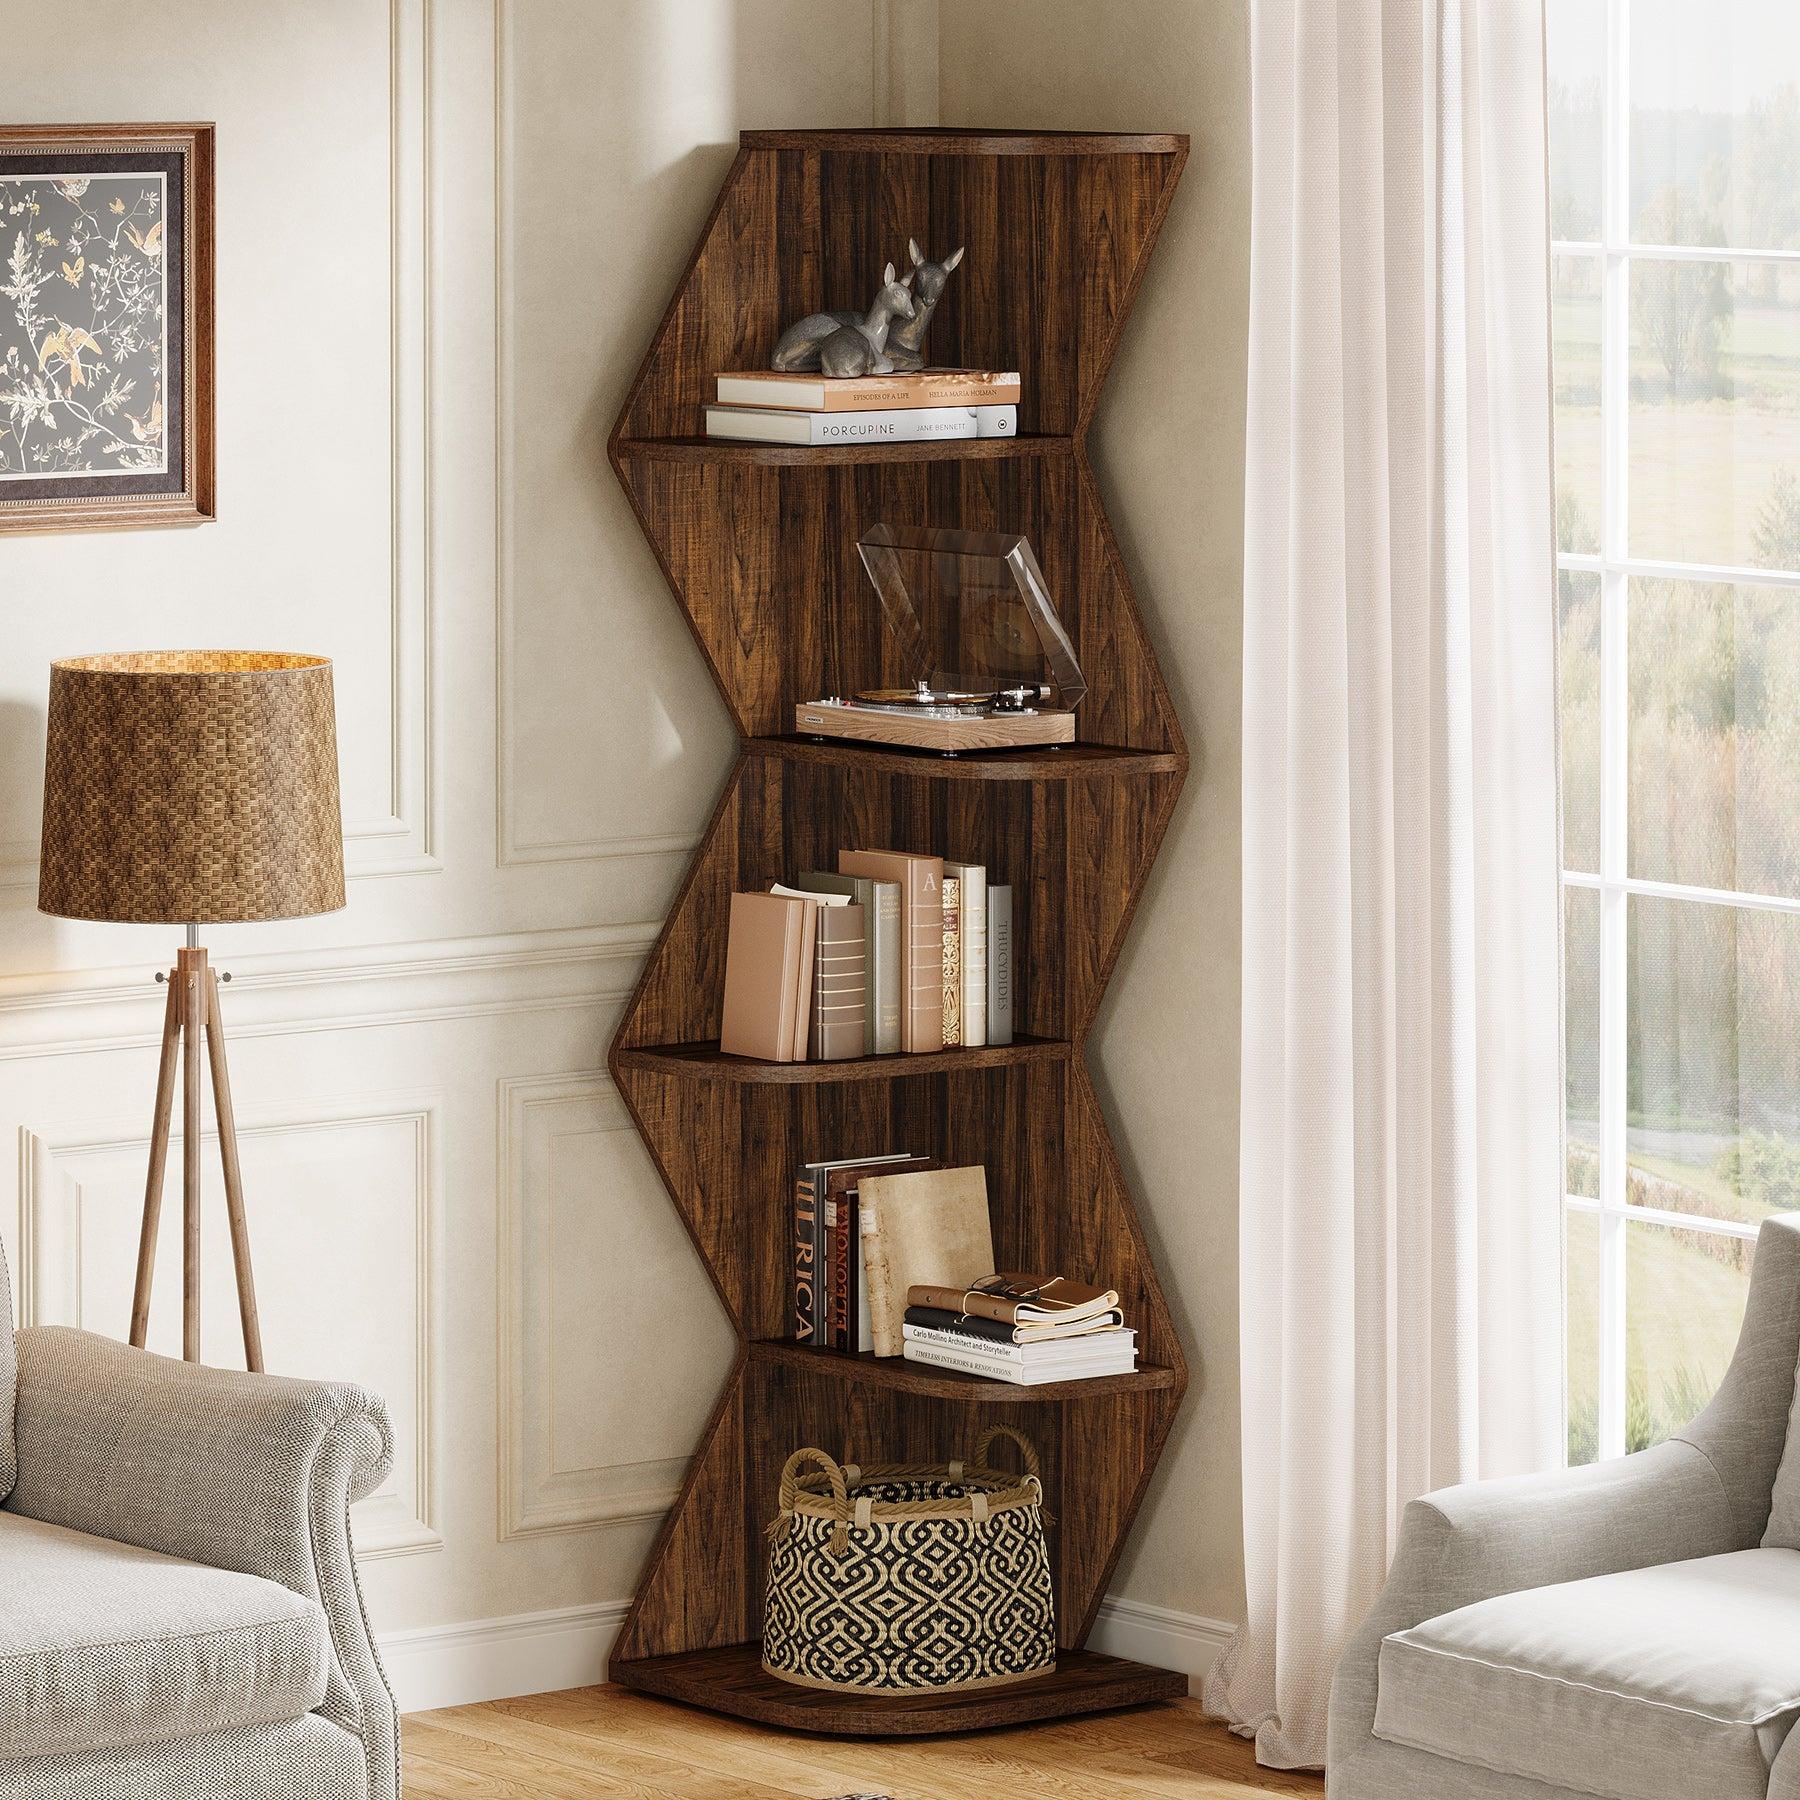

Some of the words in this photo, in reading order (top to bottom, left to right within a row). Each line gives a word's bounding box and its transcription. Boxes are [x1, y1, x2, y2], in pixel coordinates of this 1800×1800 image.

[853, 393, 882, 401] EPISODES
[896, 392, 910, 400] LIFE
[949, 389, 970, 398] MARIA
[822, 424, 895, 437] PORCUPINE
[916, 424, 934, 432] JANE
[934, 423, 966, 432] BENNETT
[922, 872, 938, 892] A
[997, 920, 1009, 1012] THUCYDIDES
[795, 1179, 815, 1341] ULRICA
[912, 1328, 928, 1339] Carlo
[927, 1331, 948, 1344] Mollino
[947, 1335, 972, 1349] Architect
[972, 1341, 982, 1350] and
[983, 1342, 1011, 1357] Storyteller
[914, 1350, 941, 1362] TIMELESS
[940, 1355, 970, 1368] INTERIORS
[974, 1362, 1013, 1377] RENOVATIONS
